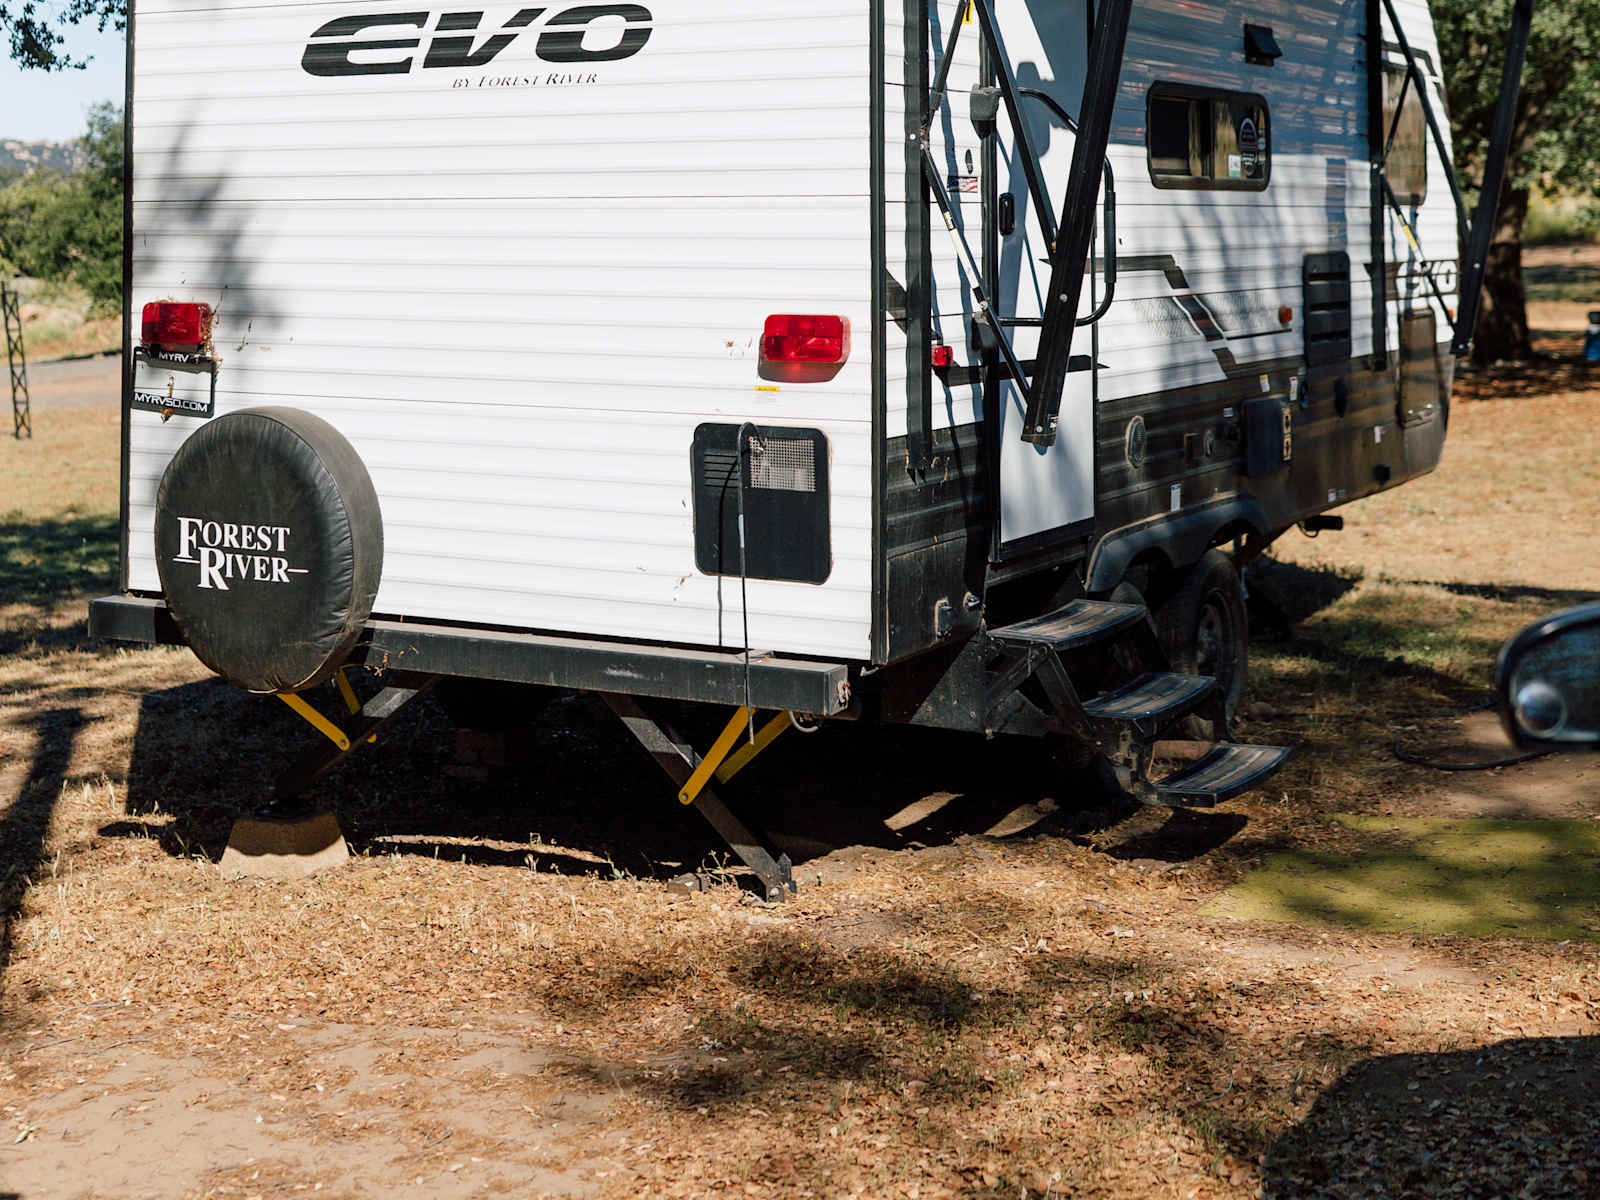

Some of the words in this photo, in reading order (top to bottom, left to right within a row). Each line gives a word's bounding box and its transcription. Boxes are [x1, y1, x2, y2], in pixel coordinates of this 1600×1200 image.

[301, 3, 653, 77] EVO
[452, 77, 470, 89] BY
[546, 72, 598, 85] RIVER
[177, 516, 290, 558] FOREST
[197, 546, 290, 591] RIVER
